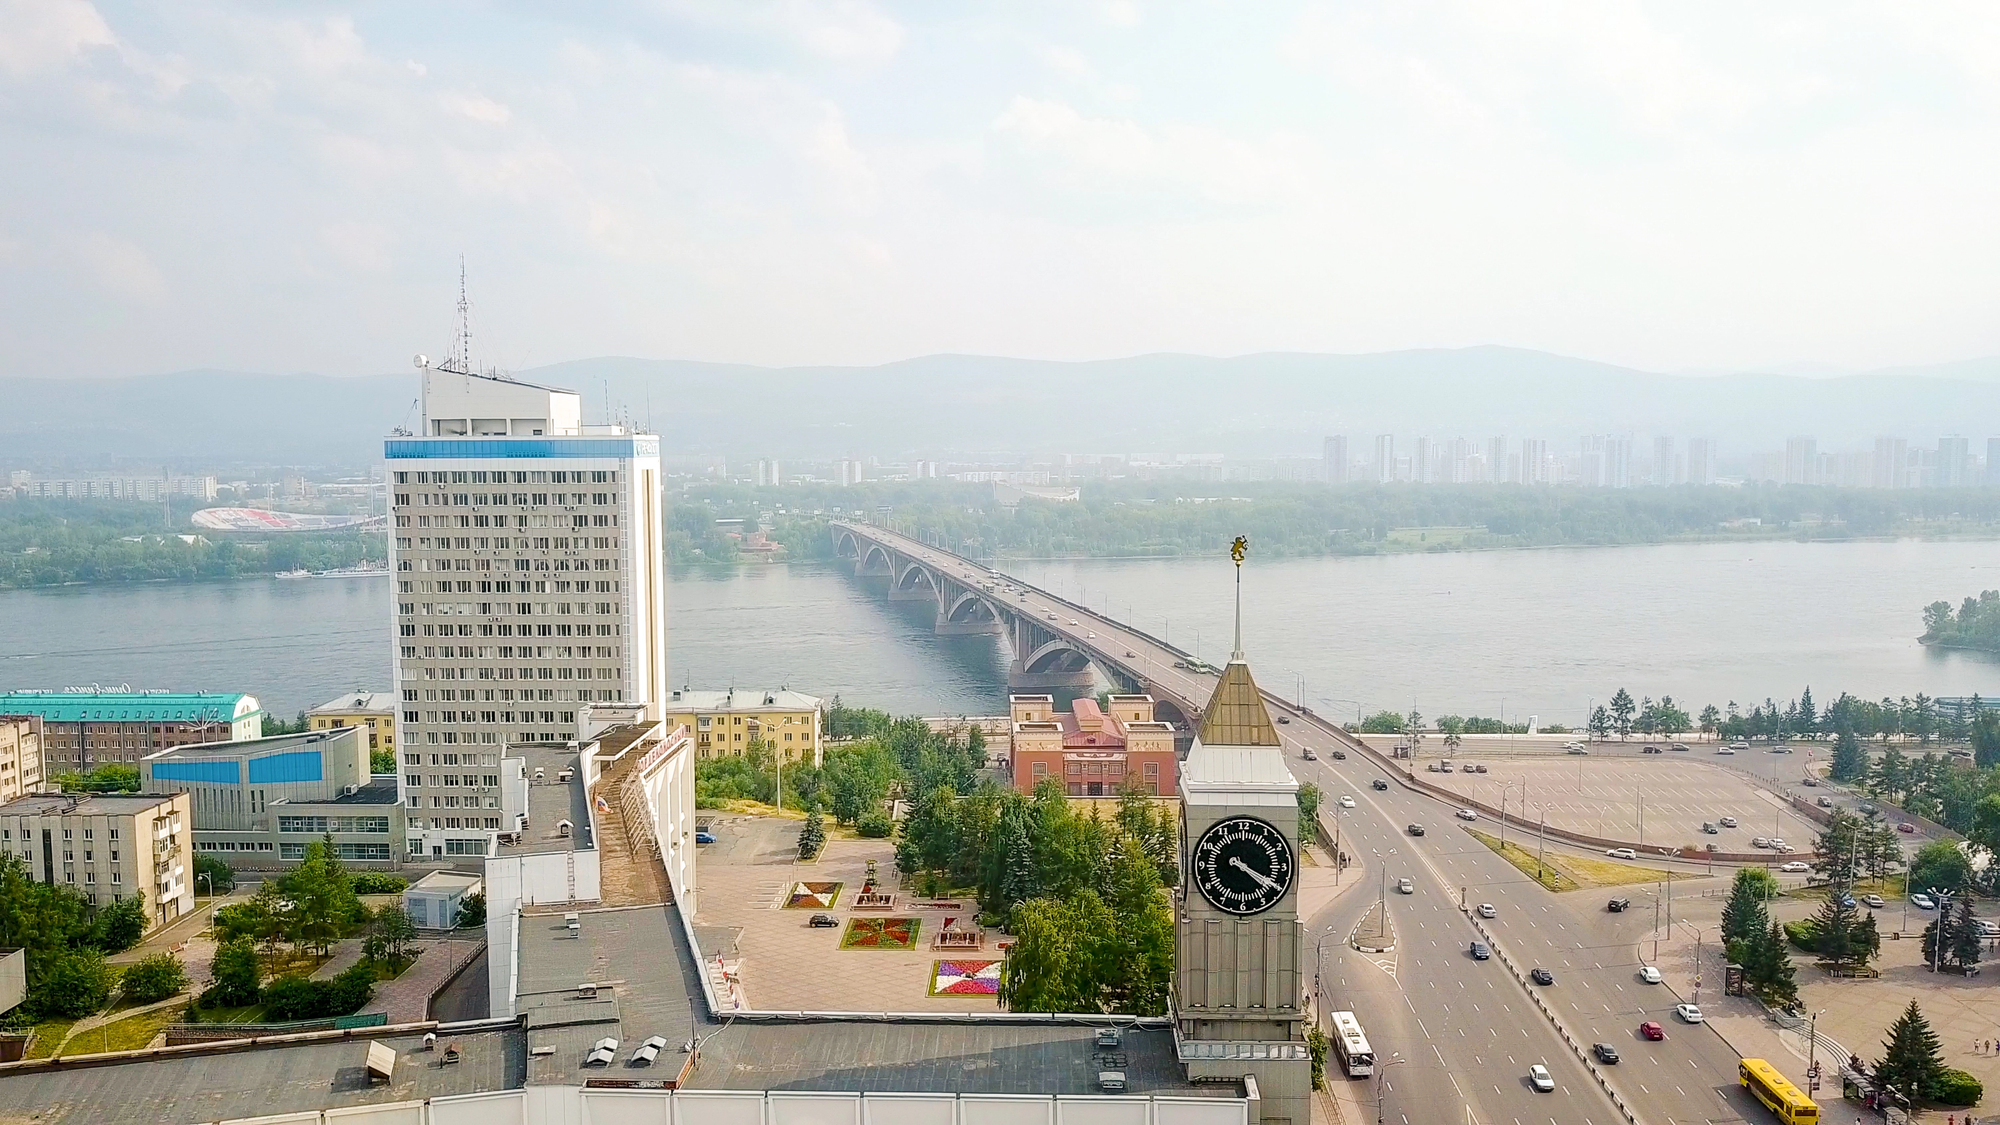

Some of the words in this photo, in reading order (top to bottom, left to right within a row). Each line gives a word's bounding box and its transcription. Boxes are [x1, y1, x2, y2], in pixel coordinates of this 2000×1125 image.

[1238, 822, 1249, 830] 12
[1203, 842, 1213, 850] 10
[1276, 843, 1282, 851] 2
[1199, 861, 1205, 870] 9
[1281, 863, 1287, 871] 3
[1205, 882, 1211, 890] 8
[1220, 897, 1226, 905] 7
[1240, 902, 1246, 911] 6
